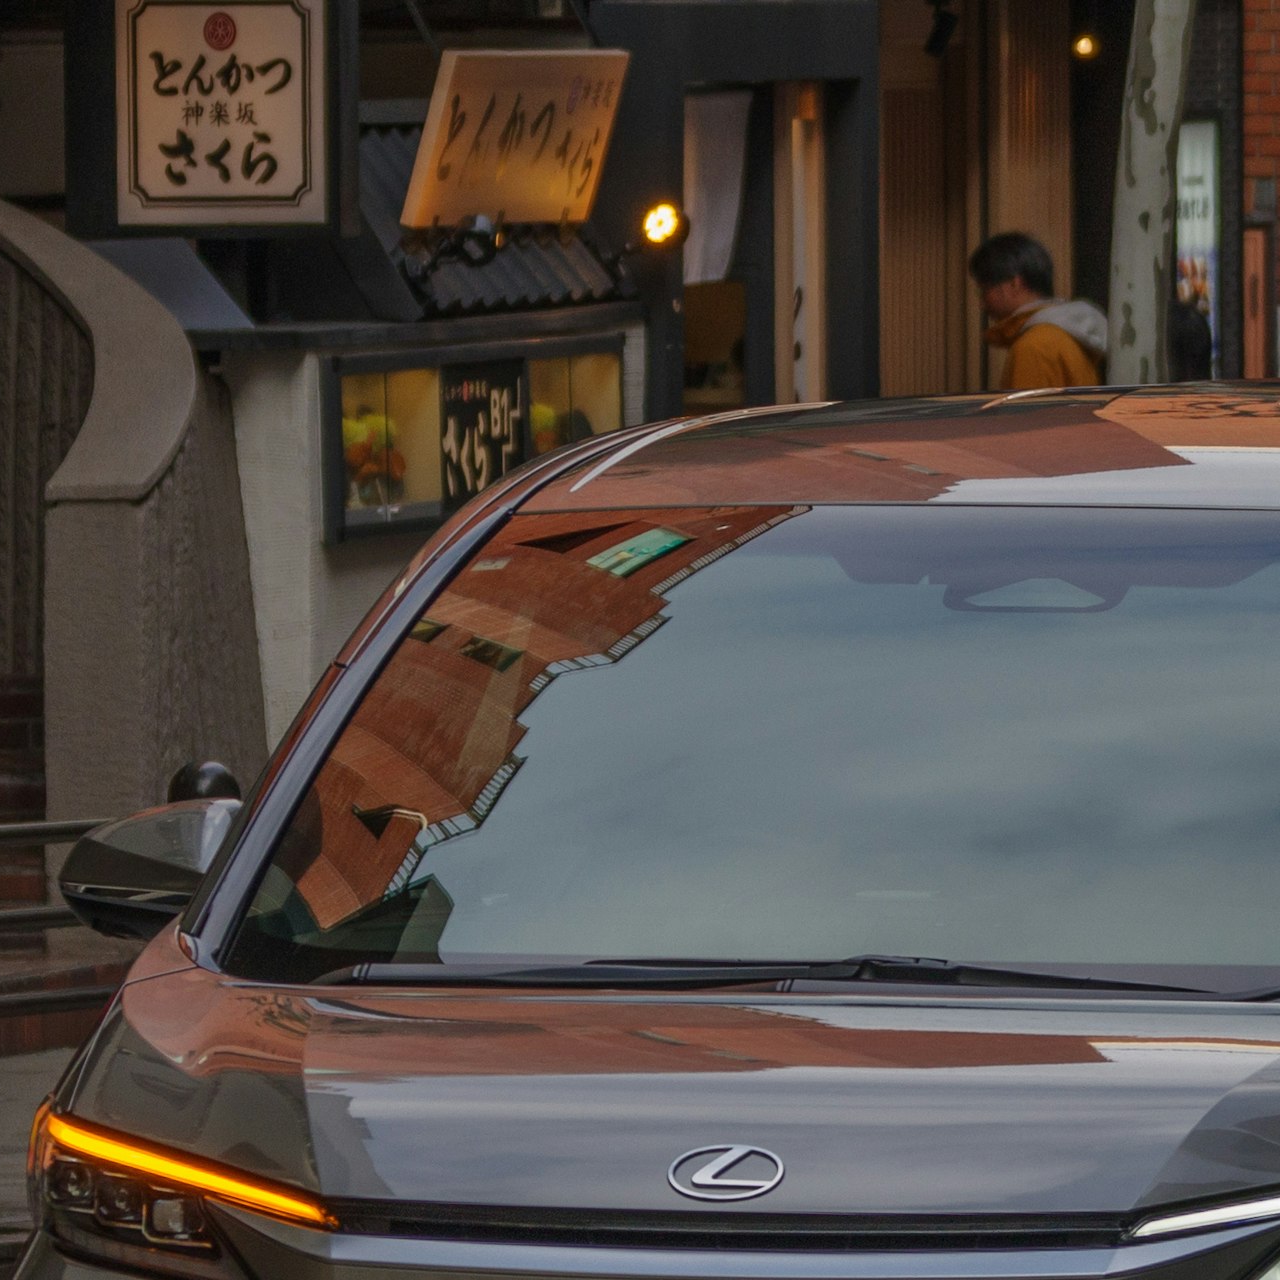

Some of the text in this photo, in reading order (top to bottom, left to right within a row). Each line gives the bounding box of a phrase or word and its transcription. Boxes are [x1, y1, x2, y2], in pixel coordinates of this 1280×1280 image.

[149, 51, 292, 97] とんかつ
[182, 100, 258, 126] 神楽坂
[437, 92, 556, 186] とんかつ
[158, 129, 278, 185] さくら
[489, 388, 510, 439] B1
[442, 411, 487, 497] さくら
